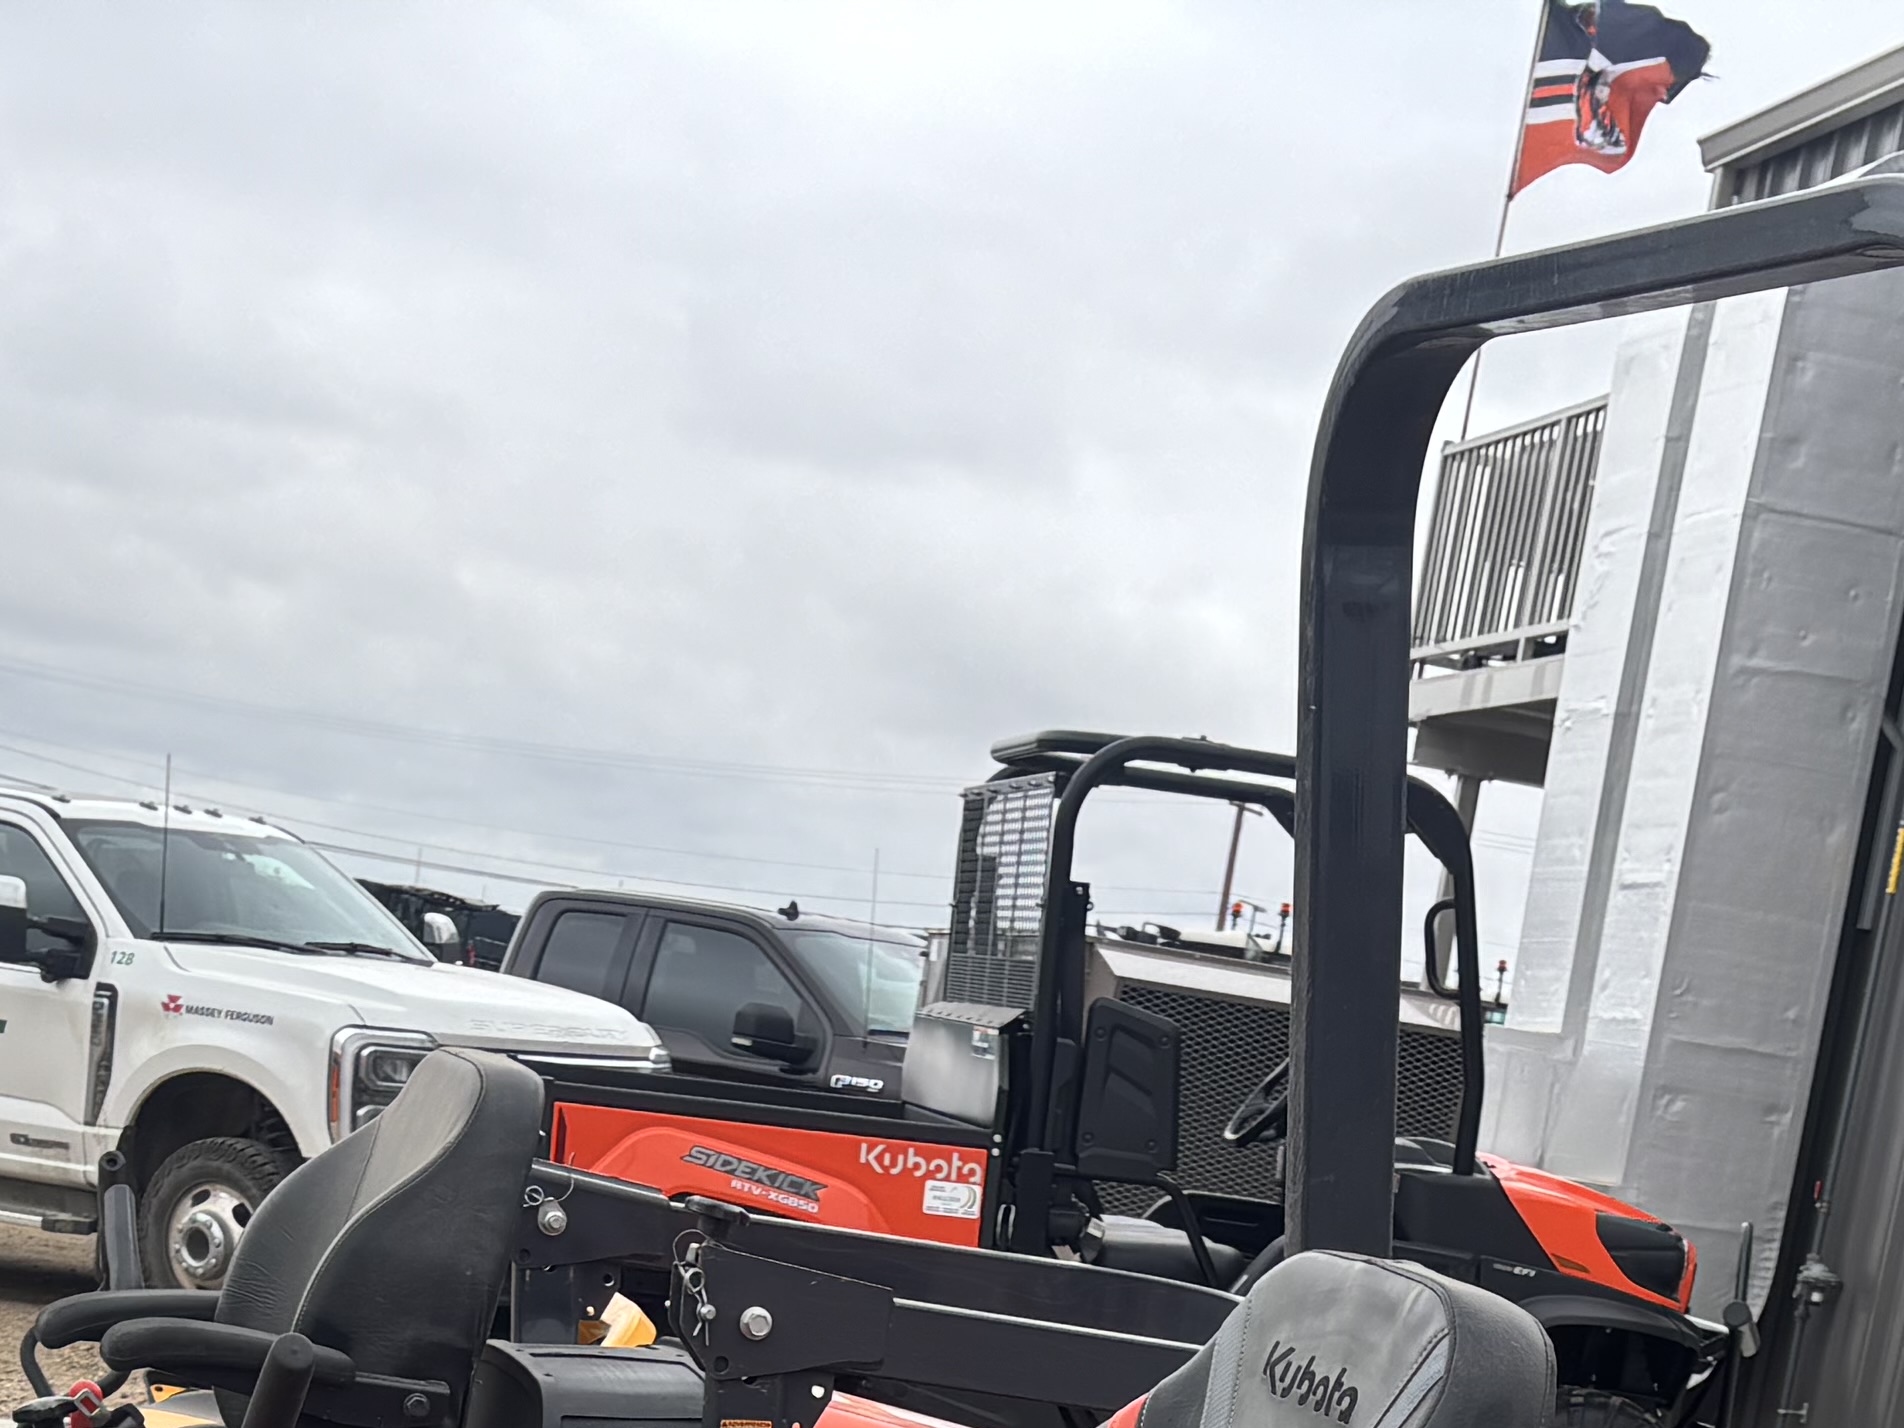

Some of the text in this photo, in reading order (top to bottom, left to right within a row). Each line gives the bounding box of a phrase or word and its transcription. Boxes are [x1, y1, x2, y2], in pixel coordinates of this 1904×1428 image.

[110, 951, 135, 965] 128
[185, 1005, 274, 1025] MASSEY FERGUSON
[683, 1146, 827, 1201] SIDEKICK
[859, 1143, 983, 1184] Kubota
[731, 1180, 819, 1214] RTV-XG850
[1263, 1341, 1359, 1424] Kubota
